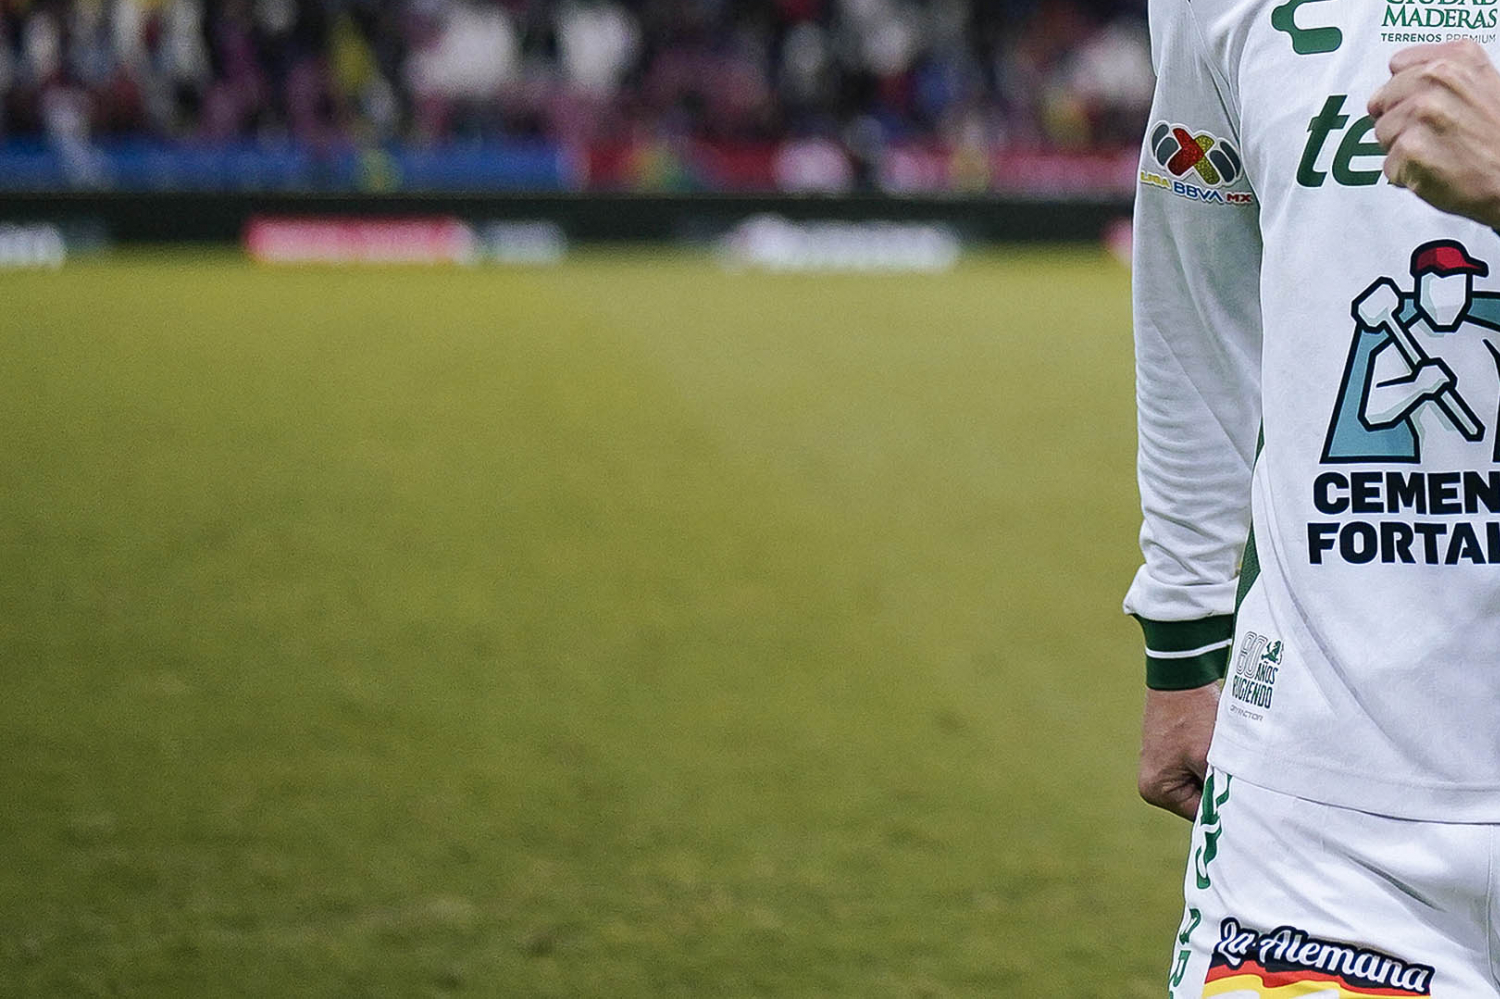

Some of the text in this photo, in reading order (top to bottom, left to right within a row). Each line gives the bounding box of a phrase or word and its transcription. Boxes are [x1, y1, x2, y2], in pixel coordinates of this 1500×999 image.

[1381, 4, 1498, 29] MADERAS
[1380, 33, 1442, 43] TERRENOS
[1139, 170, 1253, 203] LIGA BBVA MX
[1217, 921, 1257, 966] La
[1259, 928, 1430, 992] Alemana
